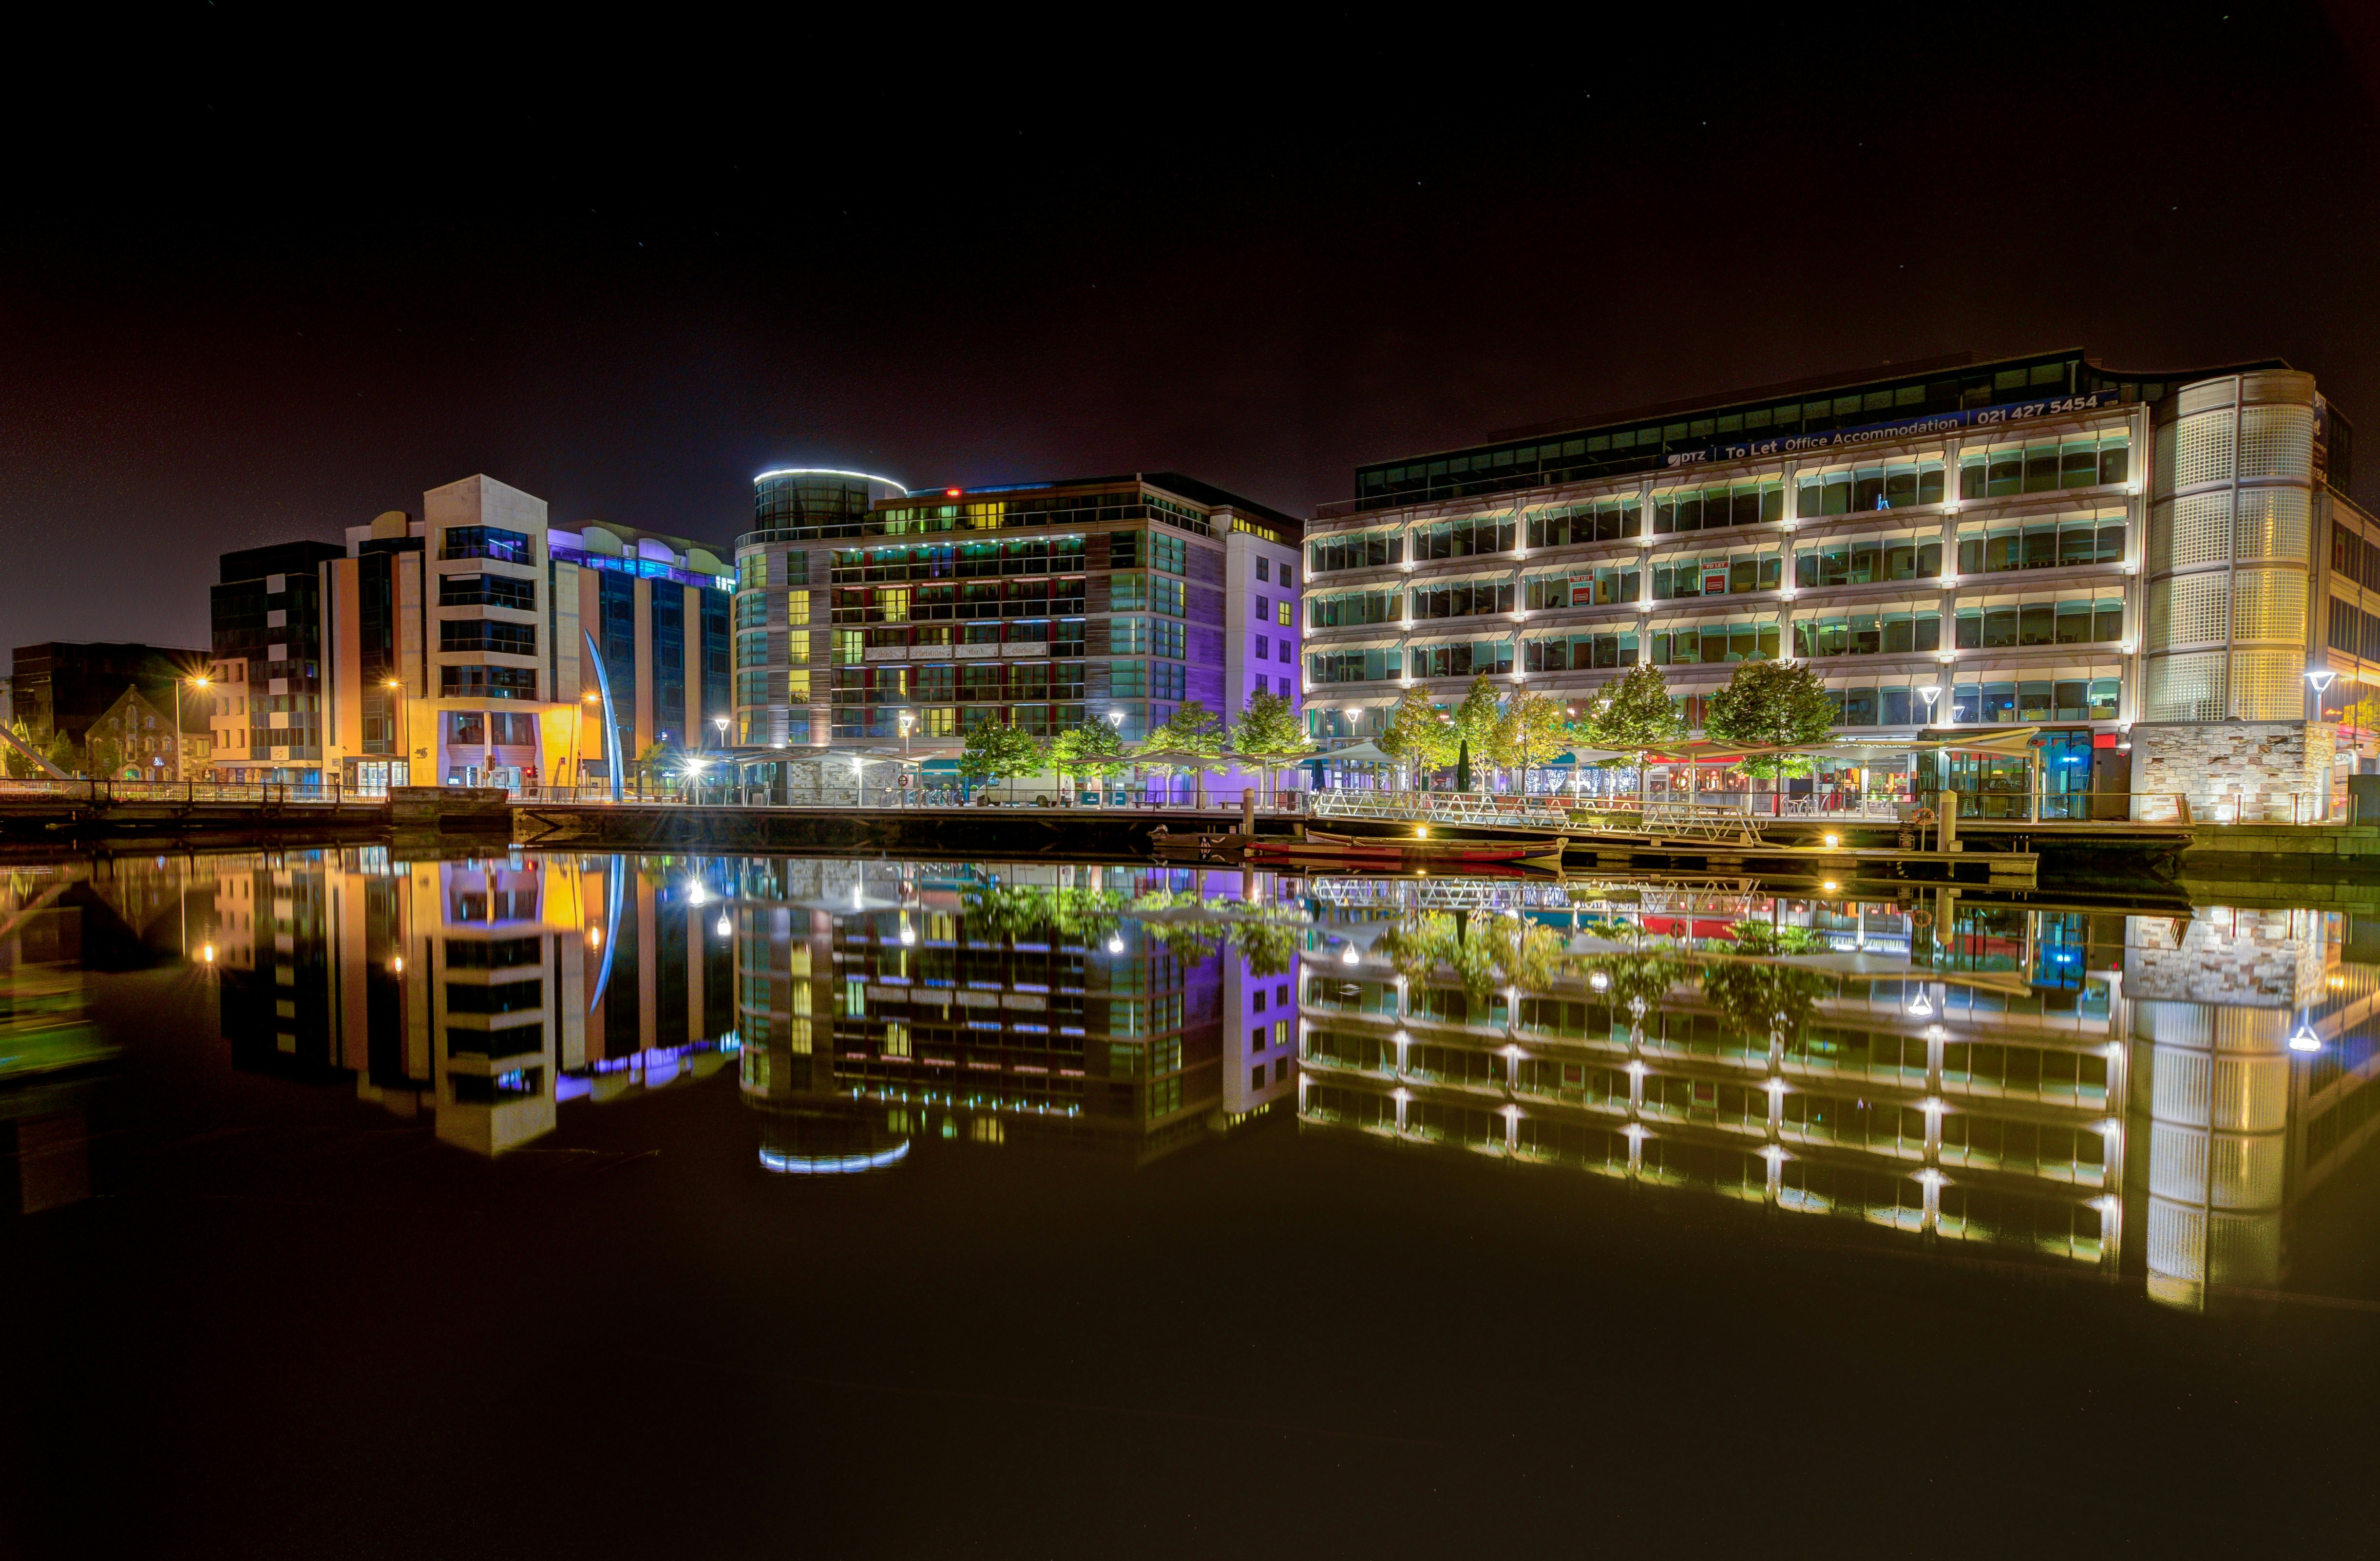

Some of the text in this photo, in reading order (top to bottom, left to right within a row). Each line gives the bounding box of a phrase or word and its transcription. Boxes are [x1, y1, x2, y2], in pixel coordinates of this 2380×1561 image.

[1726, 447, 1745, 459] To
[1751, 440, 1782, 456] Let
[1785, 436, 1828, 451] Office
[1832, 418, 1958, 445] Accommodation
[1978, 409, 2006, 425] 021
[2011, 403, 2045, 419] 427
[2050, 395, 2098, 414] 5454
[1682, 451, 1705, 462] DTZ
